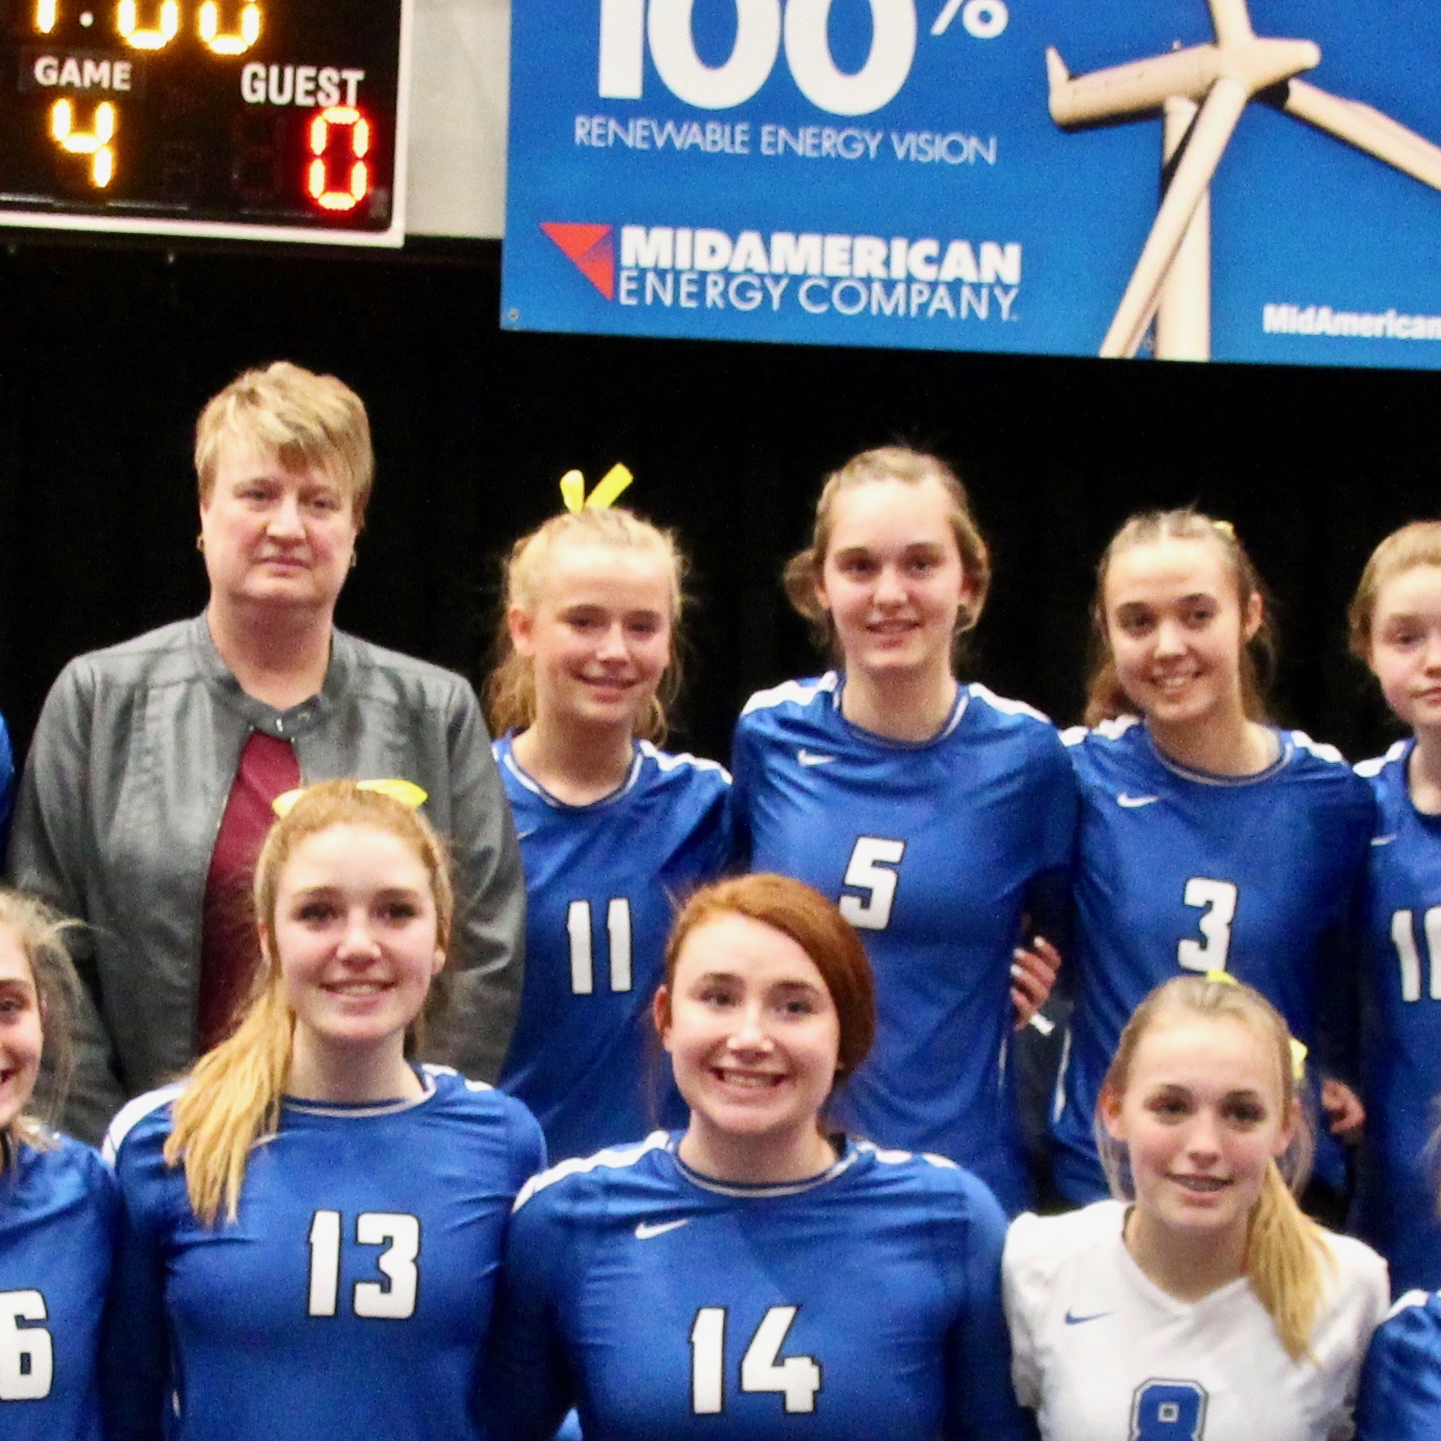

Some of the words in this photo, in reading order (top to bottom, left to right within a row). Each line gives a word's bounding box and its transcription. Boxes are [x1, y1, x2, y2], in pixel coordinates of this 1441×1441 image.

[34, 55, 132, 91] GAME
[241, 62, 365, 109] GUEST
[50, 97, 115, 189] 4
[308, 105, 370, 211] 0
[574, 115, 750, 154] RENEWABLE
[761, 126, 881, 161] ENERGY
[892, 133, 997, 165] VISION
[619, 272, 789, 312] ENERGY
[798, 278, 1019, 320] COMPANY
[620, 226, 1021, 284] MIDAMERICAN
[839, 835, 906, 931] 5
[1177, 877, 1239, 974] 3
[567, 898, 633, 994] 11
[309, 1210, 420, 1319] 13
[691, 1304, 821, 1415] 14
